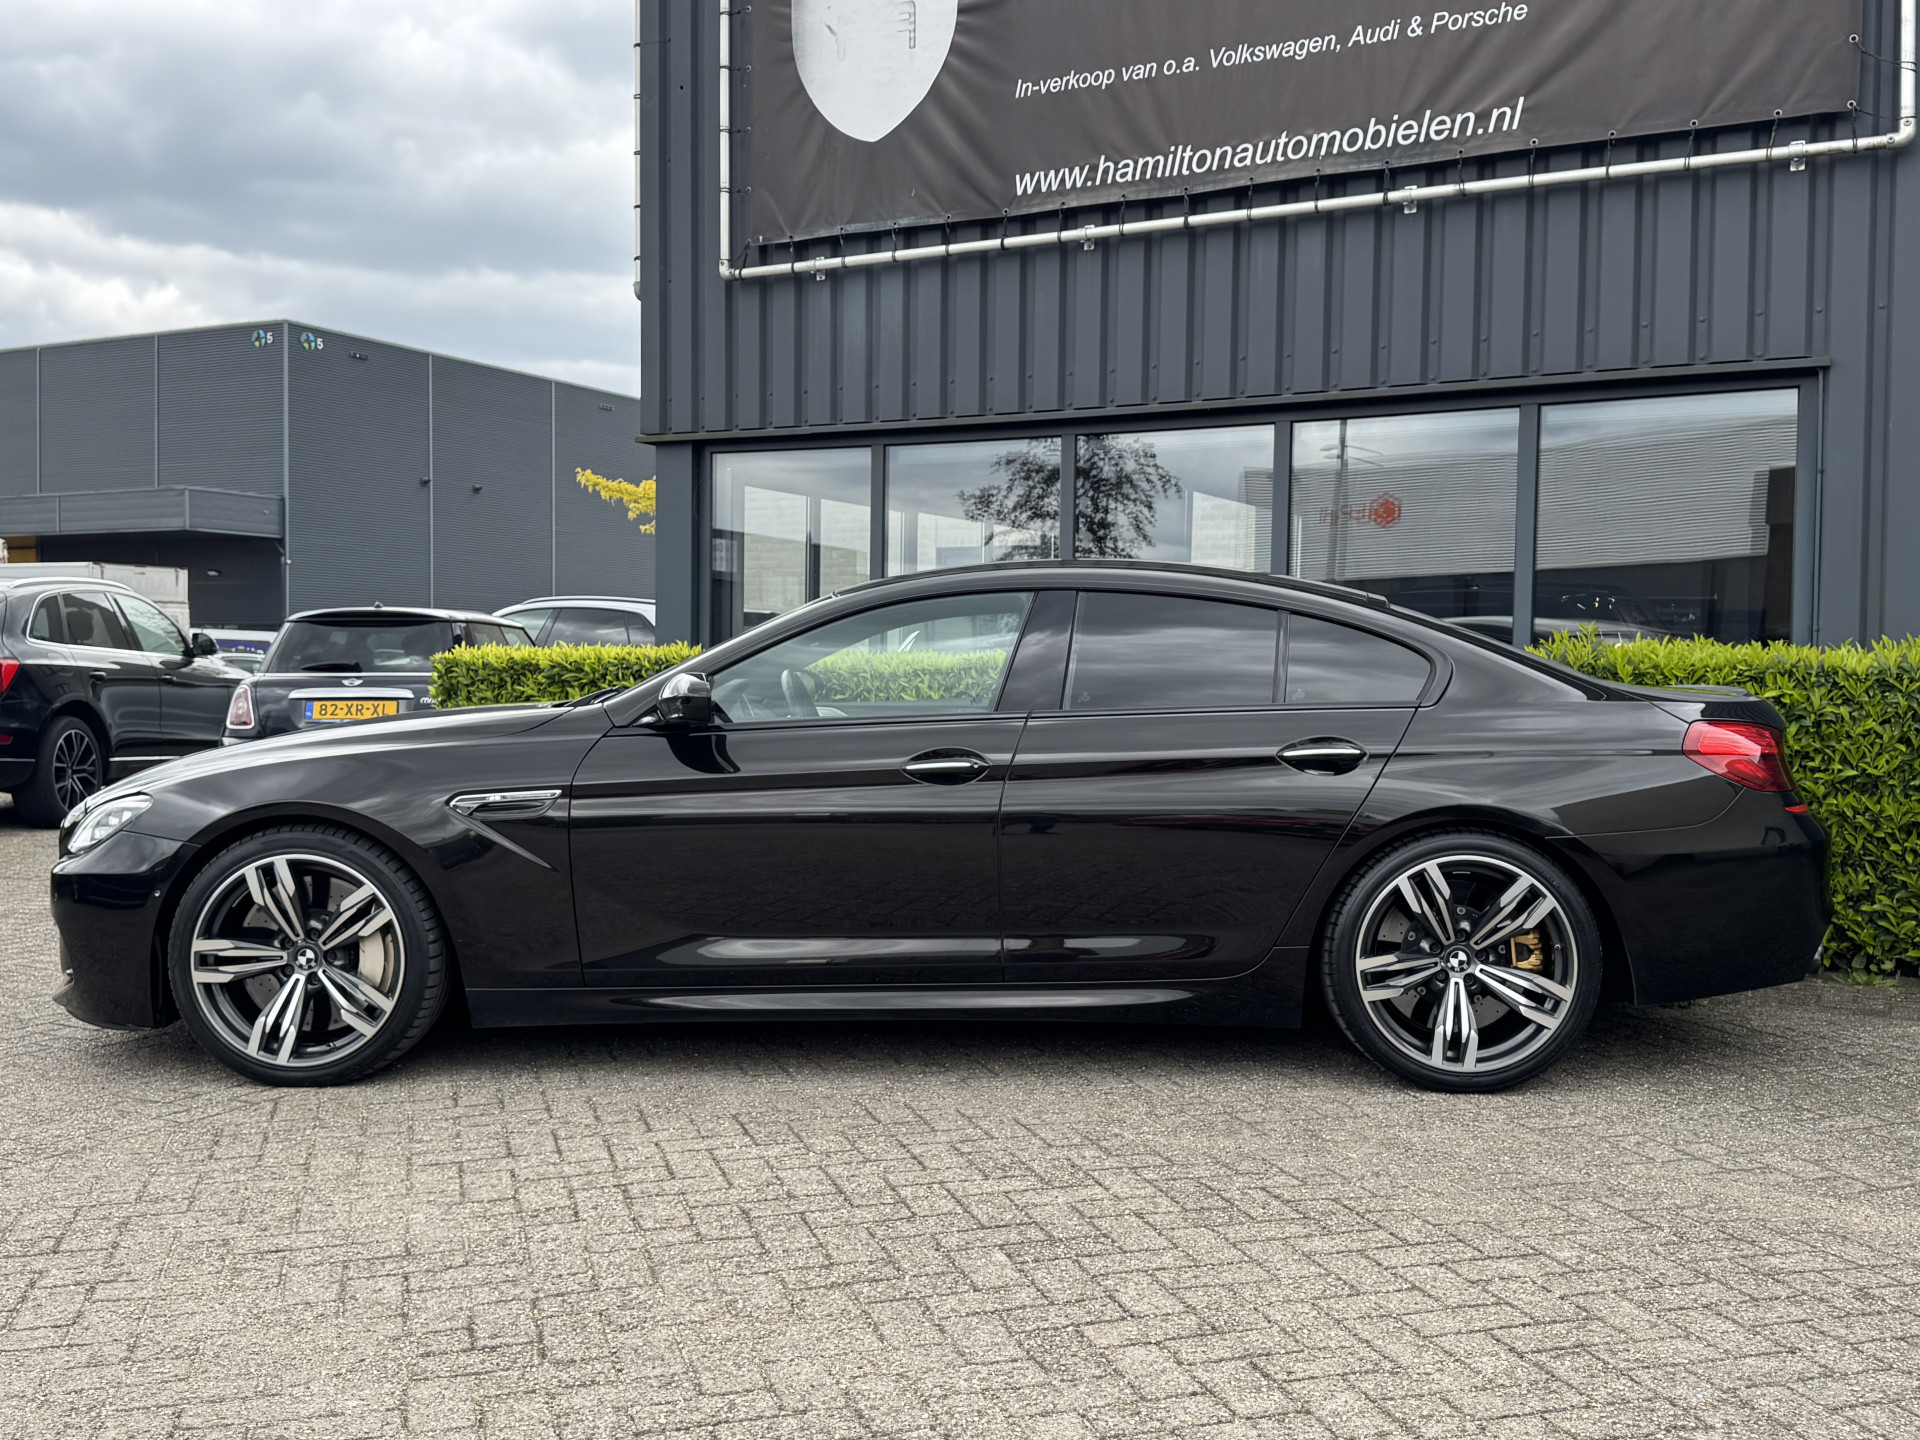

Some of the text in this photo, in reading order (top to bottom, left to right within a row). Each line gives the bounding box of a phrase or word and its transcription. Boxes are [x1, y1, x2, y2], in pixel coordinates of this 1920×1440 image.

[1015, 2, 1529, 99] In-verkoop van o.a. Volkswagen, Audi & Porsche
[1015, 96, 1525, 196] www.hamiltonautomobielen.nl
